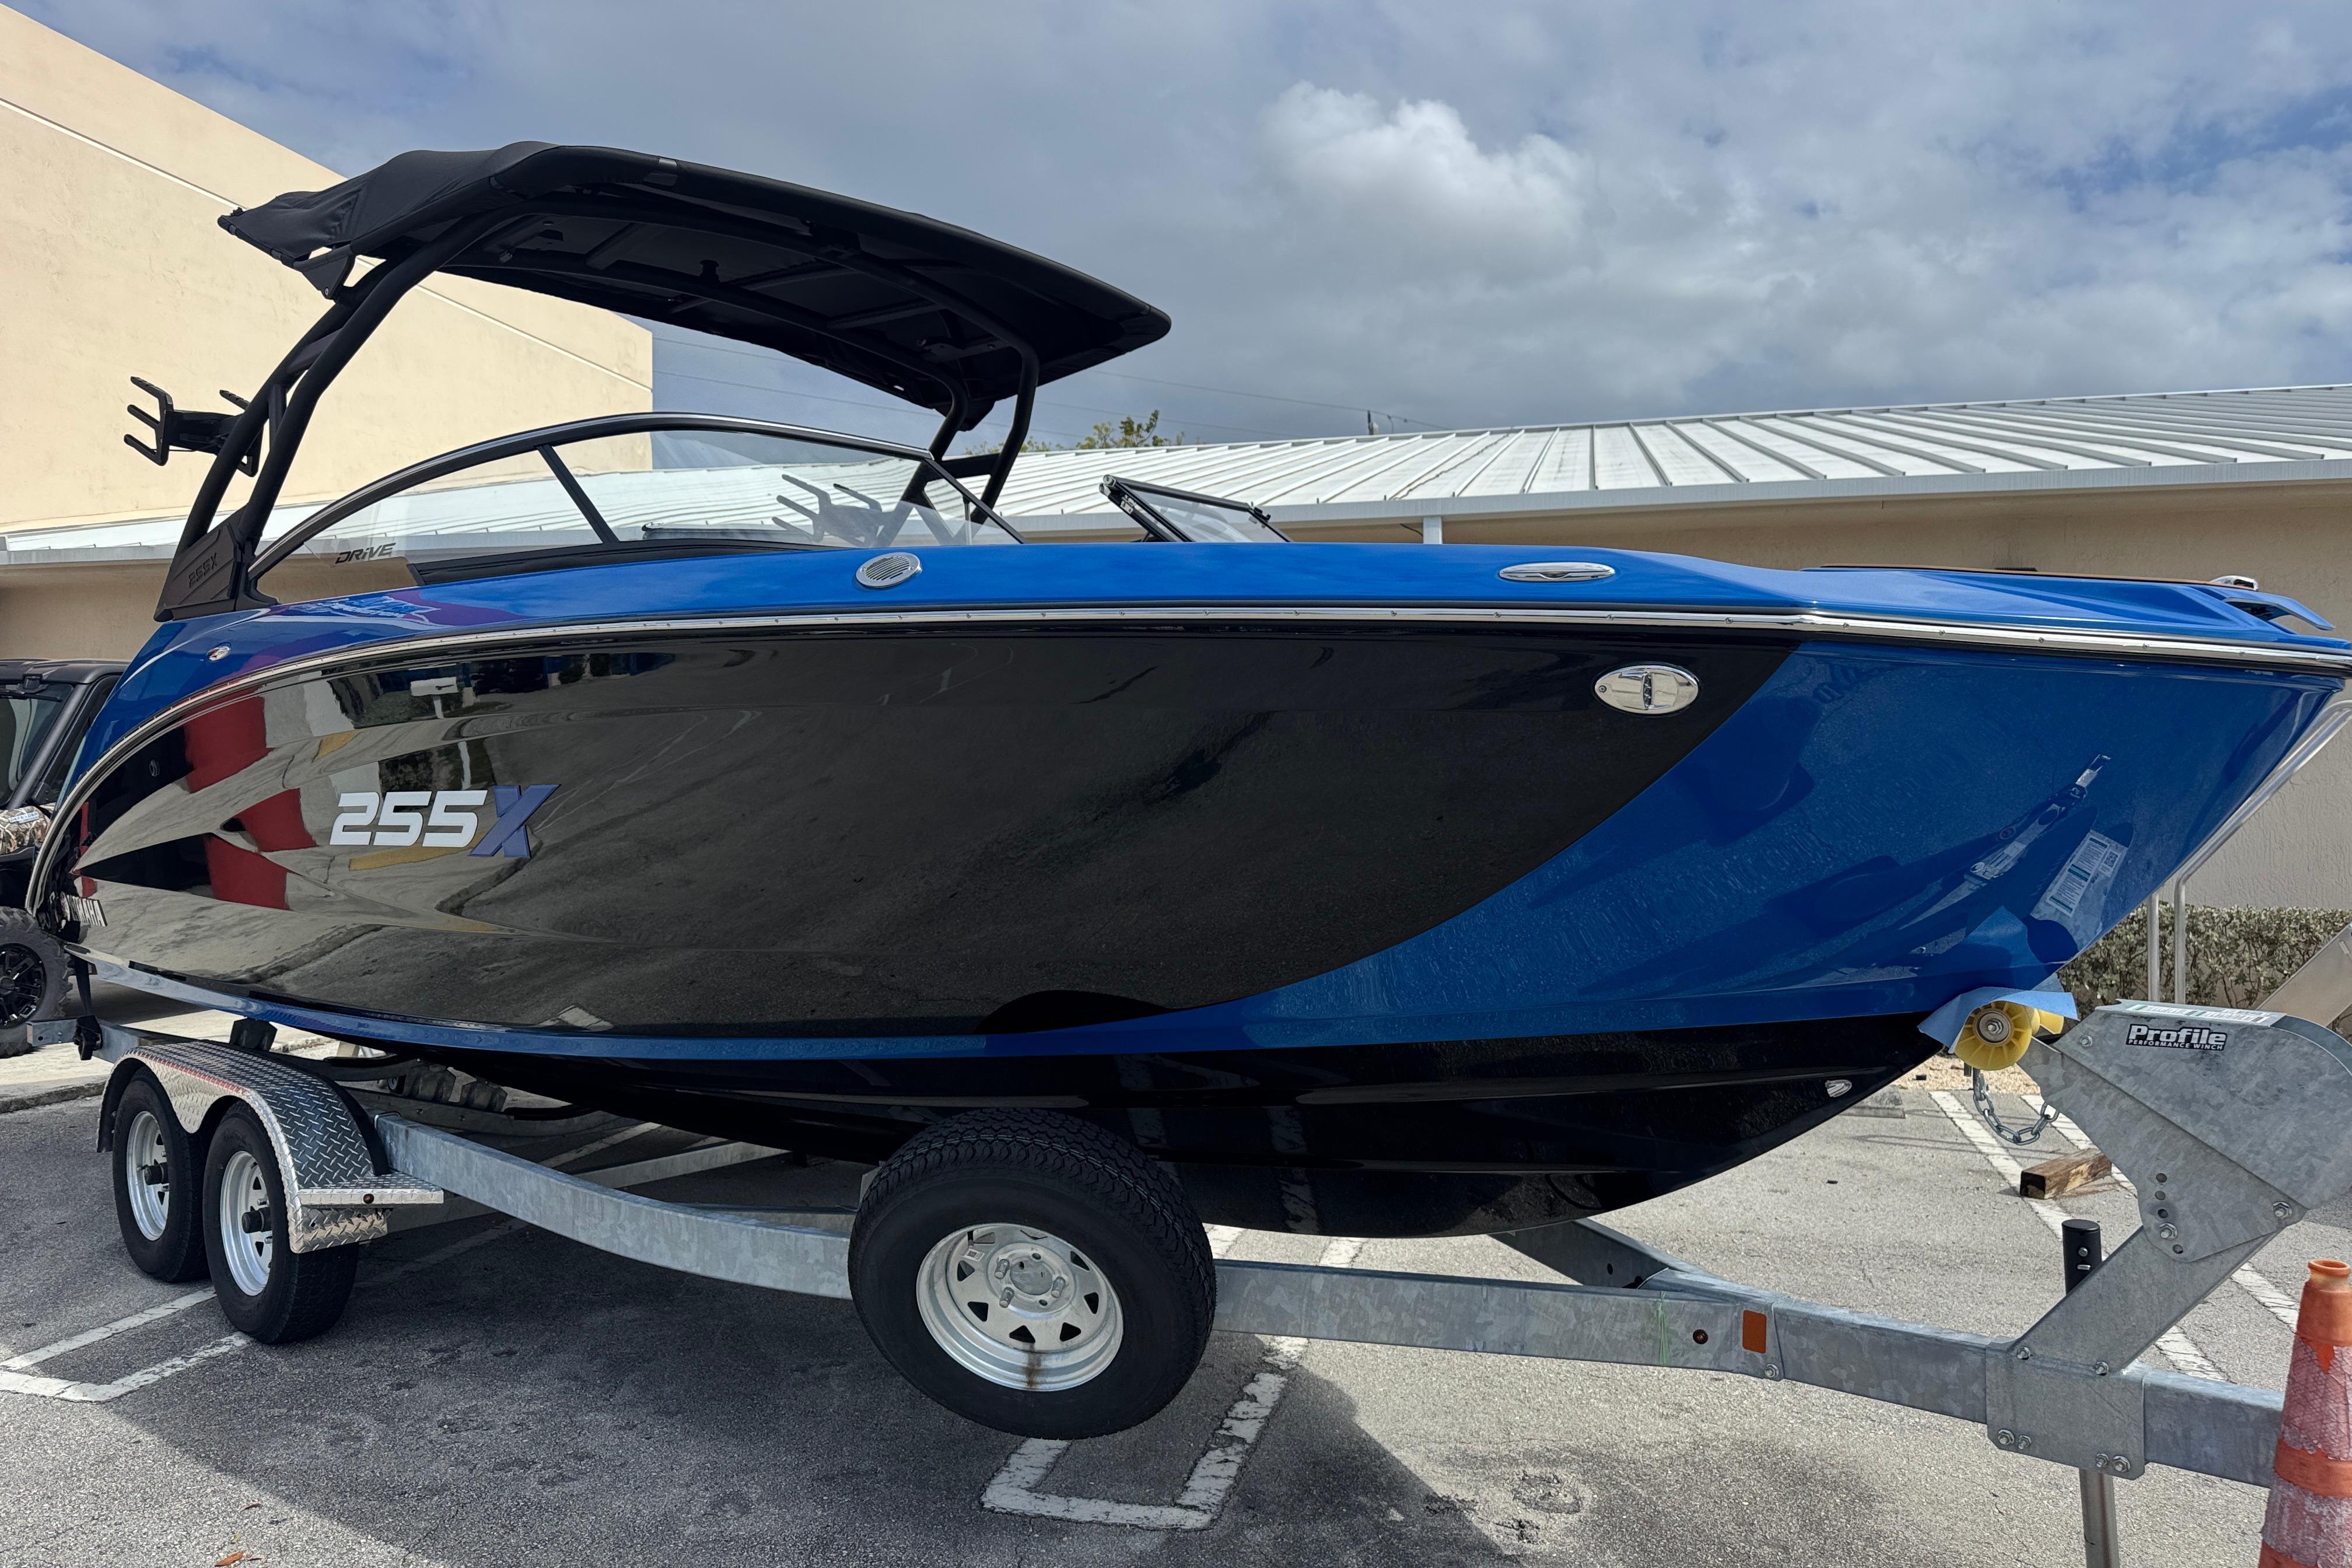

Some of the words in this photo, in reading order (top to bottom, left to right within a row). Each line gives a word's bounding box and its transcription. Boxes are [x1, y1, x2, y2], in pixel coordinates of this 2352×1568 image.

[330, 785, 561, 858] 255X
[2128, 1039, 2190, 1048] PERFORMANCE
[2129, 1025, 2226, 1045] Profile
